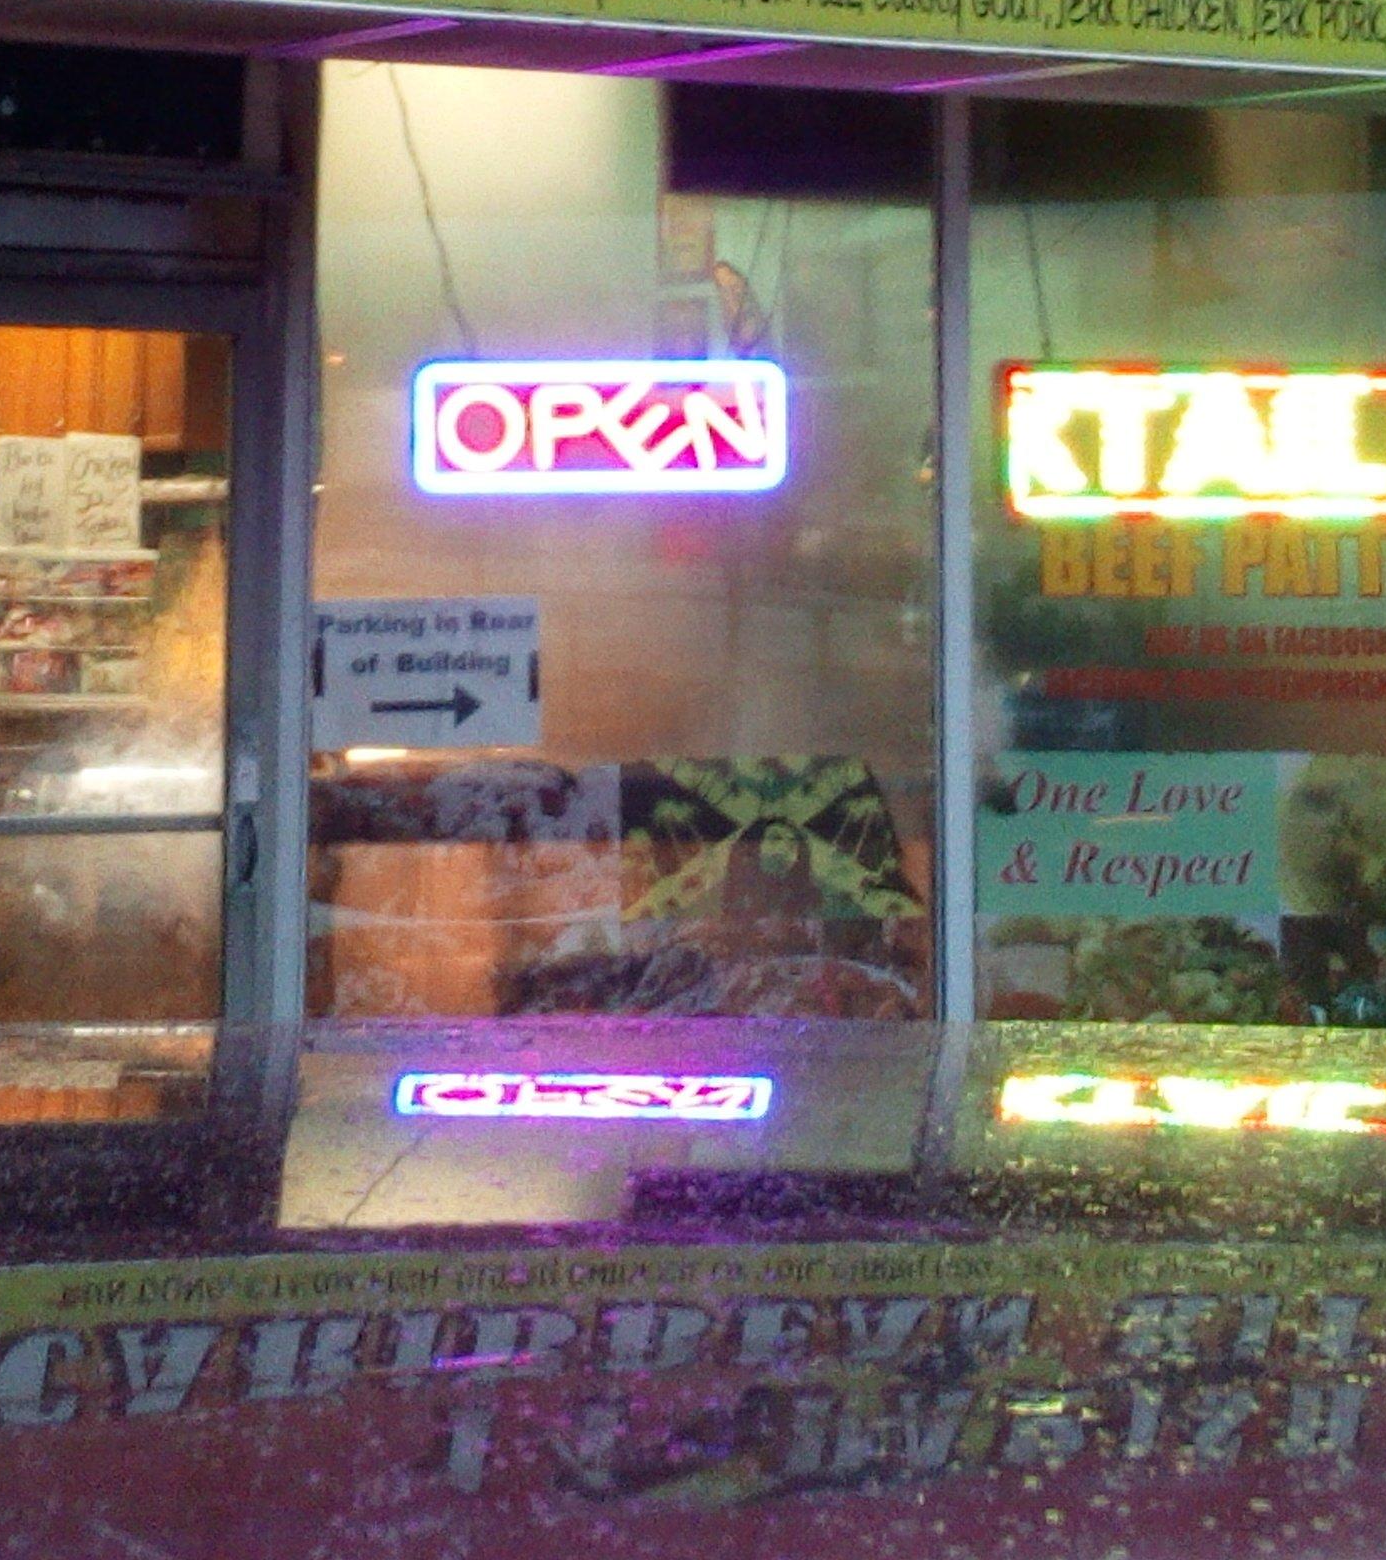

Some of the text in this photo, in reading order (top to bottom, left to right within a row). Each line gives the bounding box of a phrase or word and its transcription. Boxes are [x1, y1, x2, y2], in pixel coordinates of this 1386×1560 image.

[436, 380, 770, 473] OPEN
[1038, 520, 1215, 598] BEEF
[317, 614, 427, 638] Parking
[350, 650, 511, 676] of Building
[1010, 767, 1245, 813] One Love
[999, 839, 1255, 898] & Respect
